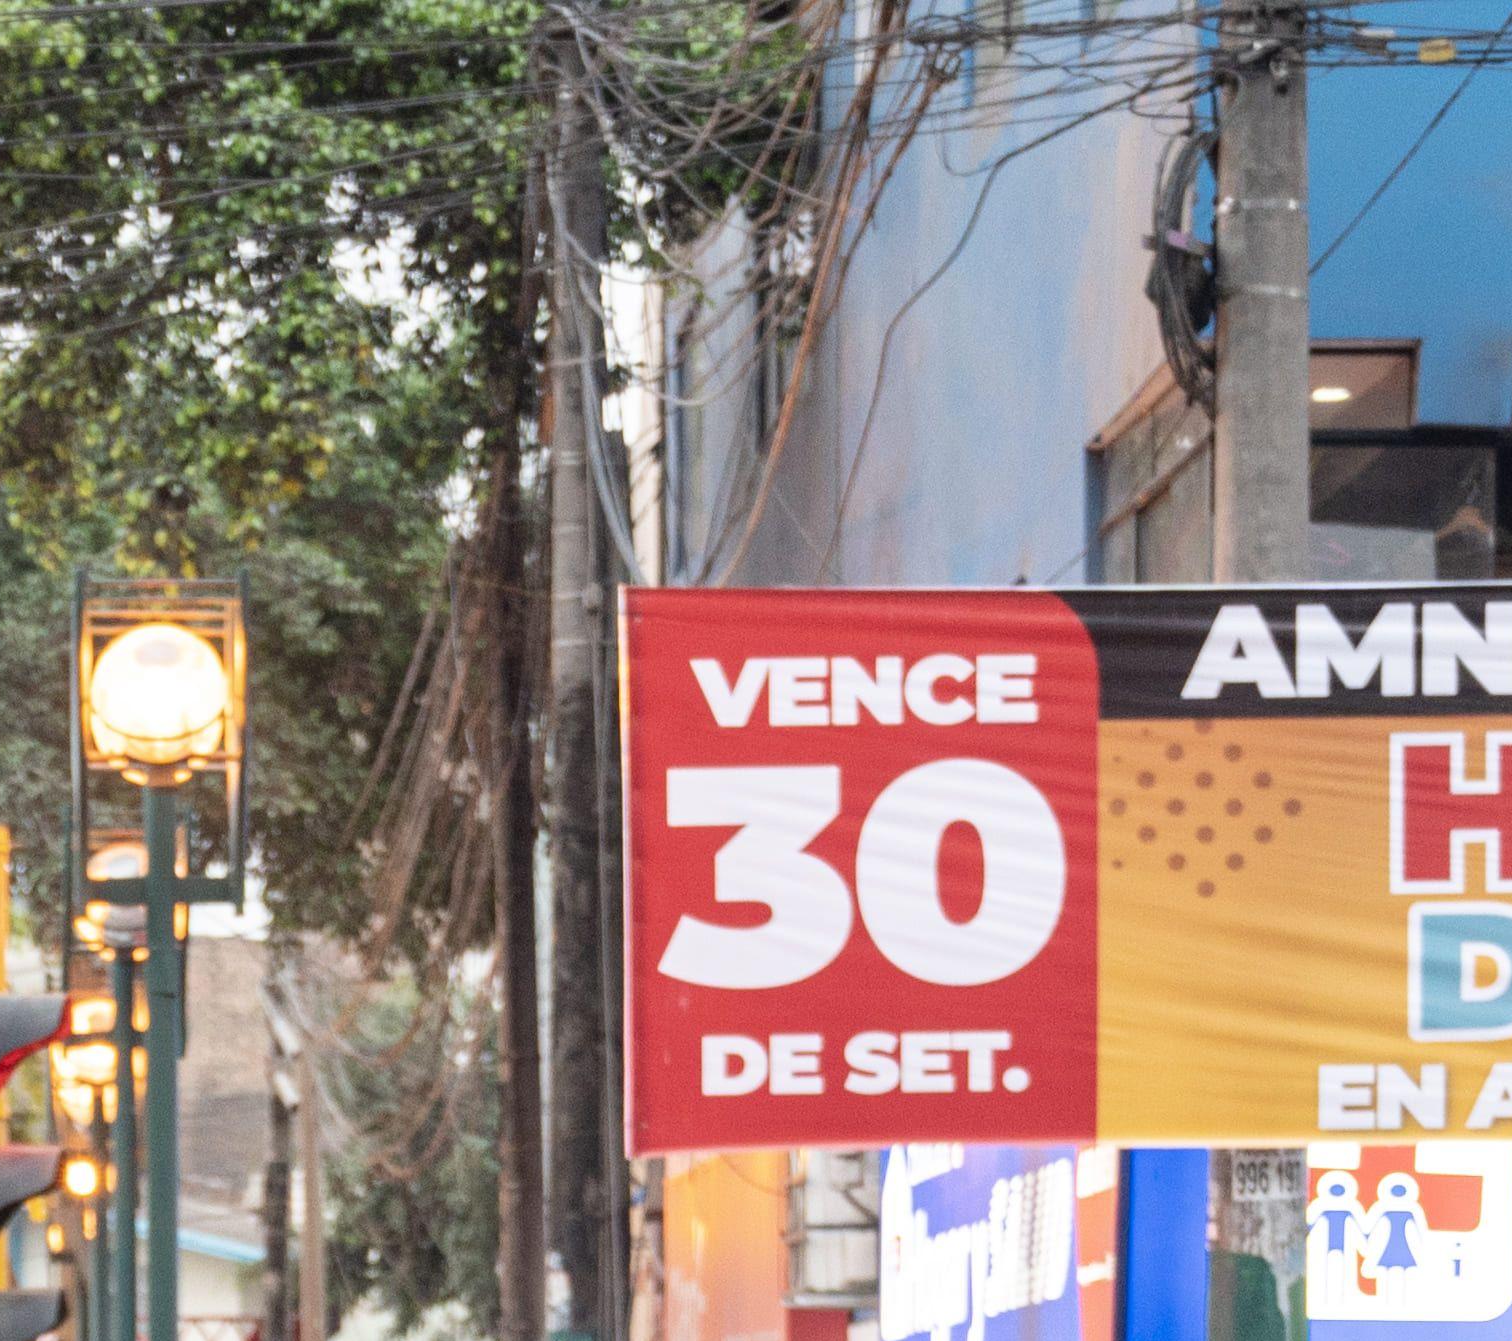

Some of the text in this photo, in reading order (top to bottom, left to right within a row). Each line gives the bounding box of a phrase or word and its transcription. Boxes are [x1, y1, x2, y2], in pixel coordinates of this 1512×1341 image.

[689, 652, 1039, 728] VENCE
[657, 757, 1066, 989] 30
[700, 1030, 1031, 1097] DE SET.
[1317, 1063, 1451, 1131] EN
